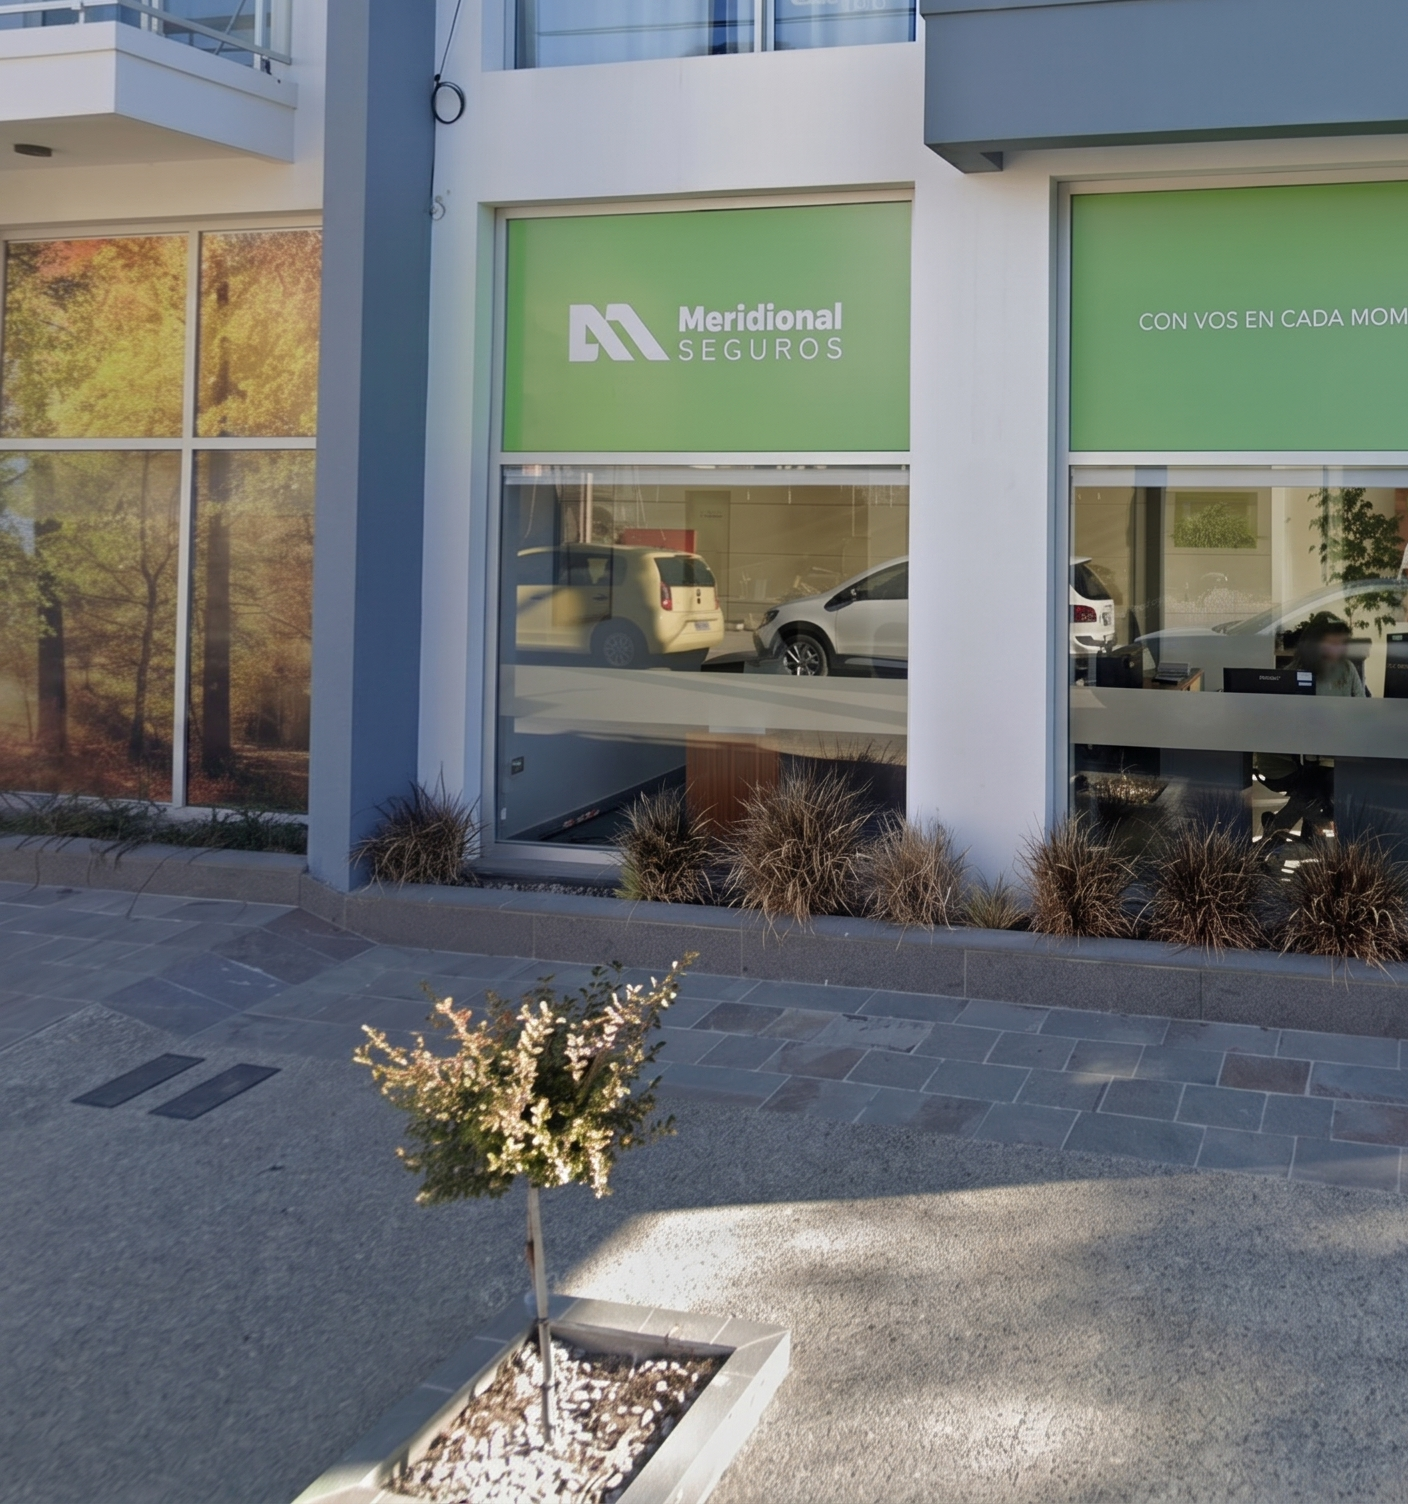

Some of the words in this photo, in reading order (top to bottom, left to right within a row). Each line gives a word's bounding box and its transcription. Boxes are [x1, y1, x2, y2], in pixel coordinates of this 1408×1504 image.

[679, 302, 842, 332] Meridional
[1139, 312, 1187, 331] CON
[1194, 311, 1238, 330] VOS
[1246, 310, 1274, 328] EN
[1281, 308, 1344, 328] CADA
[679, 337, 842, 361] SEGUROS
